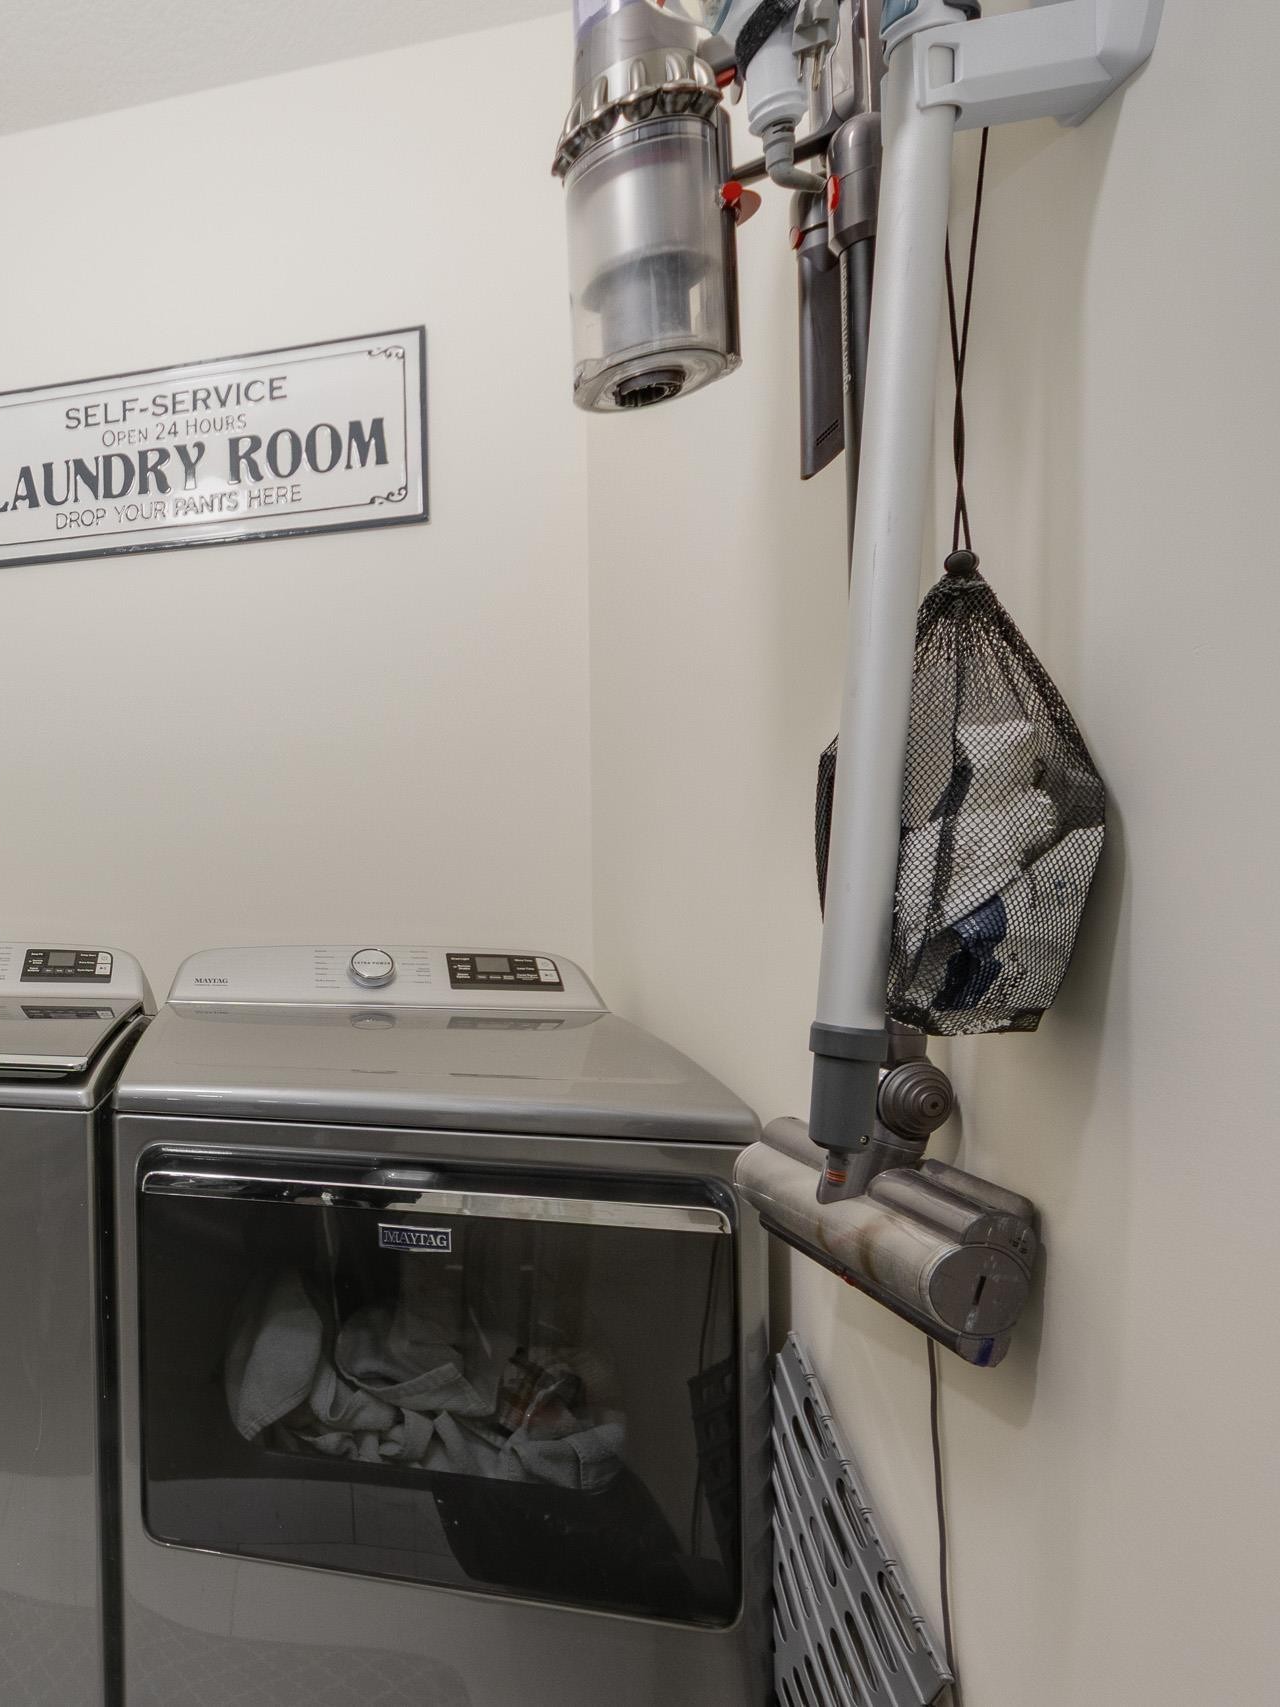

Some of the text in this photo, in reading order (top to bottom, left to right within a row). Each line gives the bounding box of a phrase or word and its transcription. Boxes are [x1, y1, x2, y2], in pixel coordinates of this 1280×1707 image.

[65, 376, 288, 430] SELF-SERVICE
[101, 413, 247, 447] OPEN 24 HOURS
[228, 417, 389, 485] ROOM
[55, 484, 303, 530] DROP YOUR PANTS HERE
[382, 1229, 449, 1248] MAYTAG
